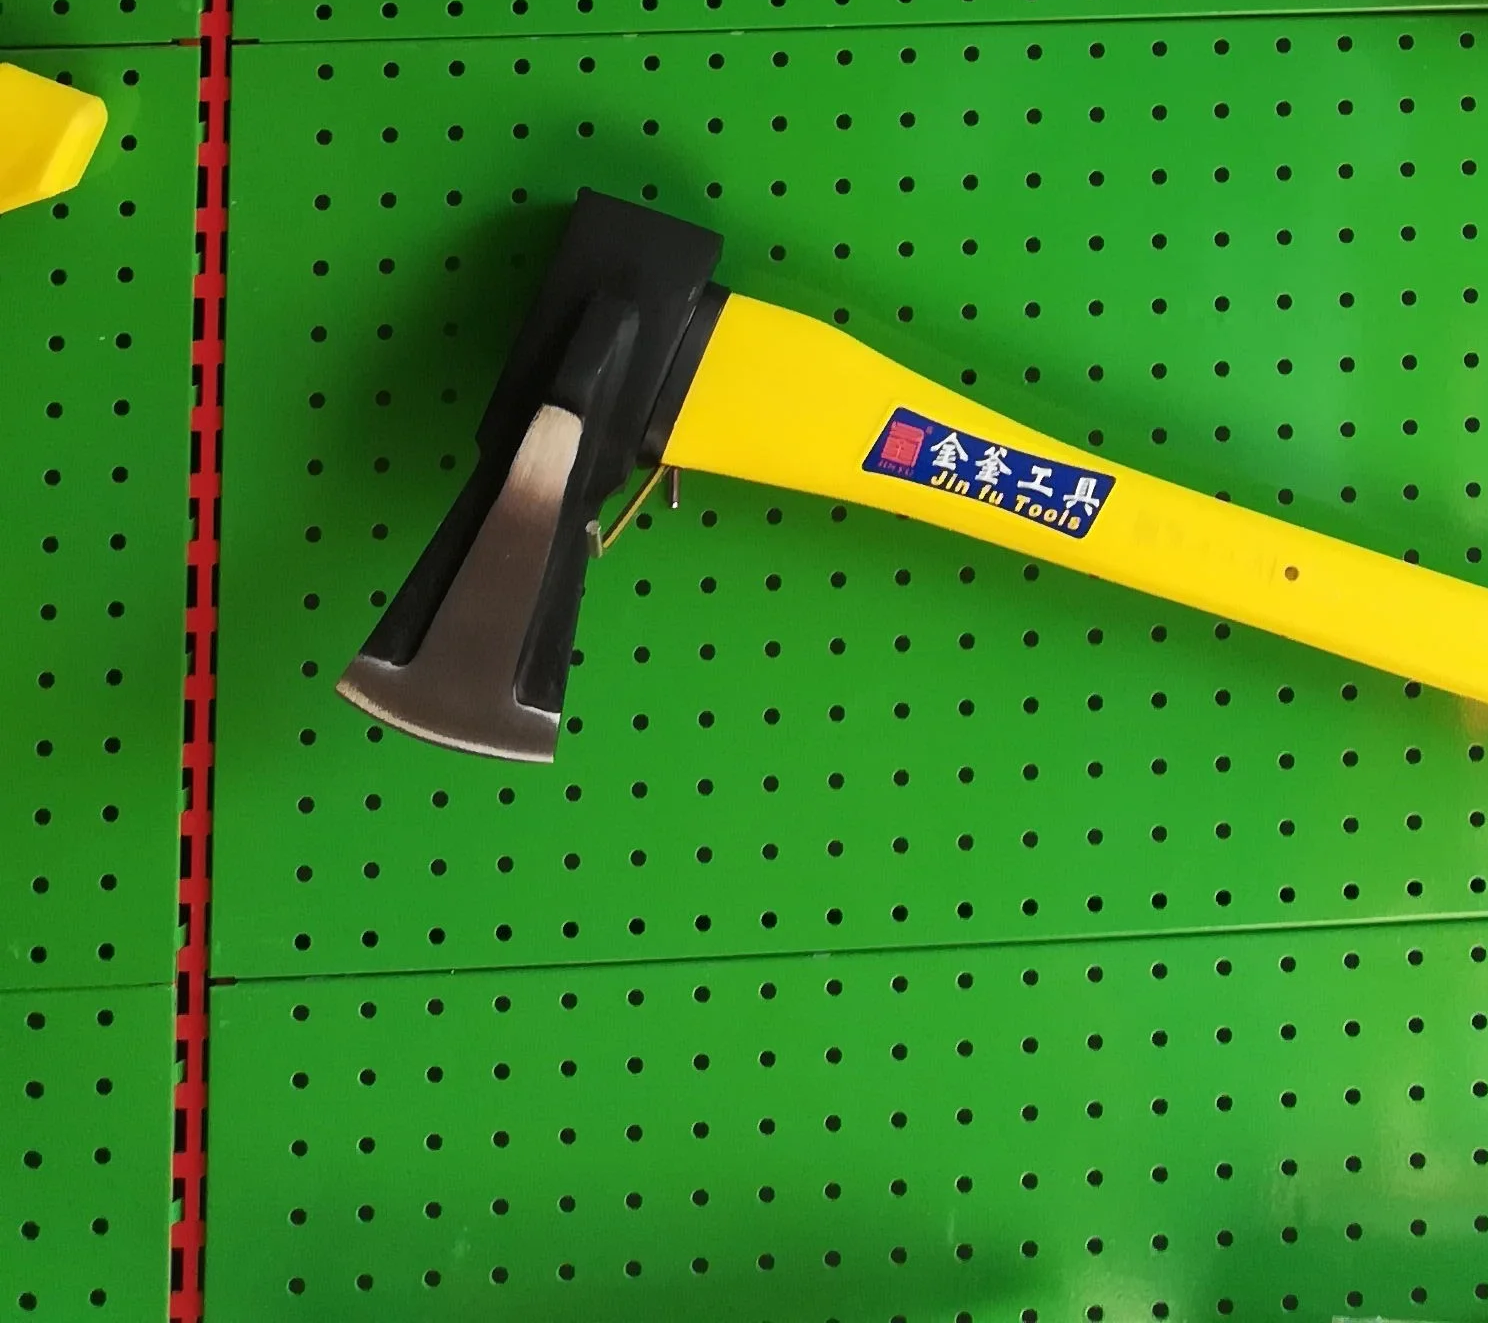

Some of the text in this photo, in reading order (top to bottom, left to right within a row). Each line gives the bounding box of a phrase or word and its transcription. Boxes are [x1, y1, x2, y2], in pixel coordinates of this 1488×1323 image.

[930, 432, 1100, 516] 金釜工具
[930, 470, 970, 494] Jin
[1013, 495, 1081, 531] Tools
